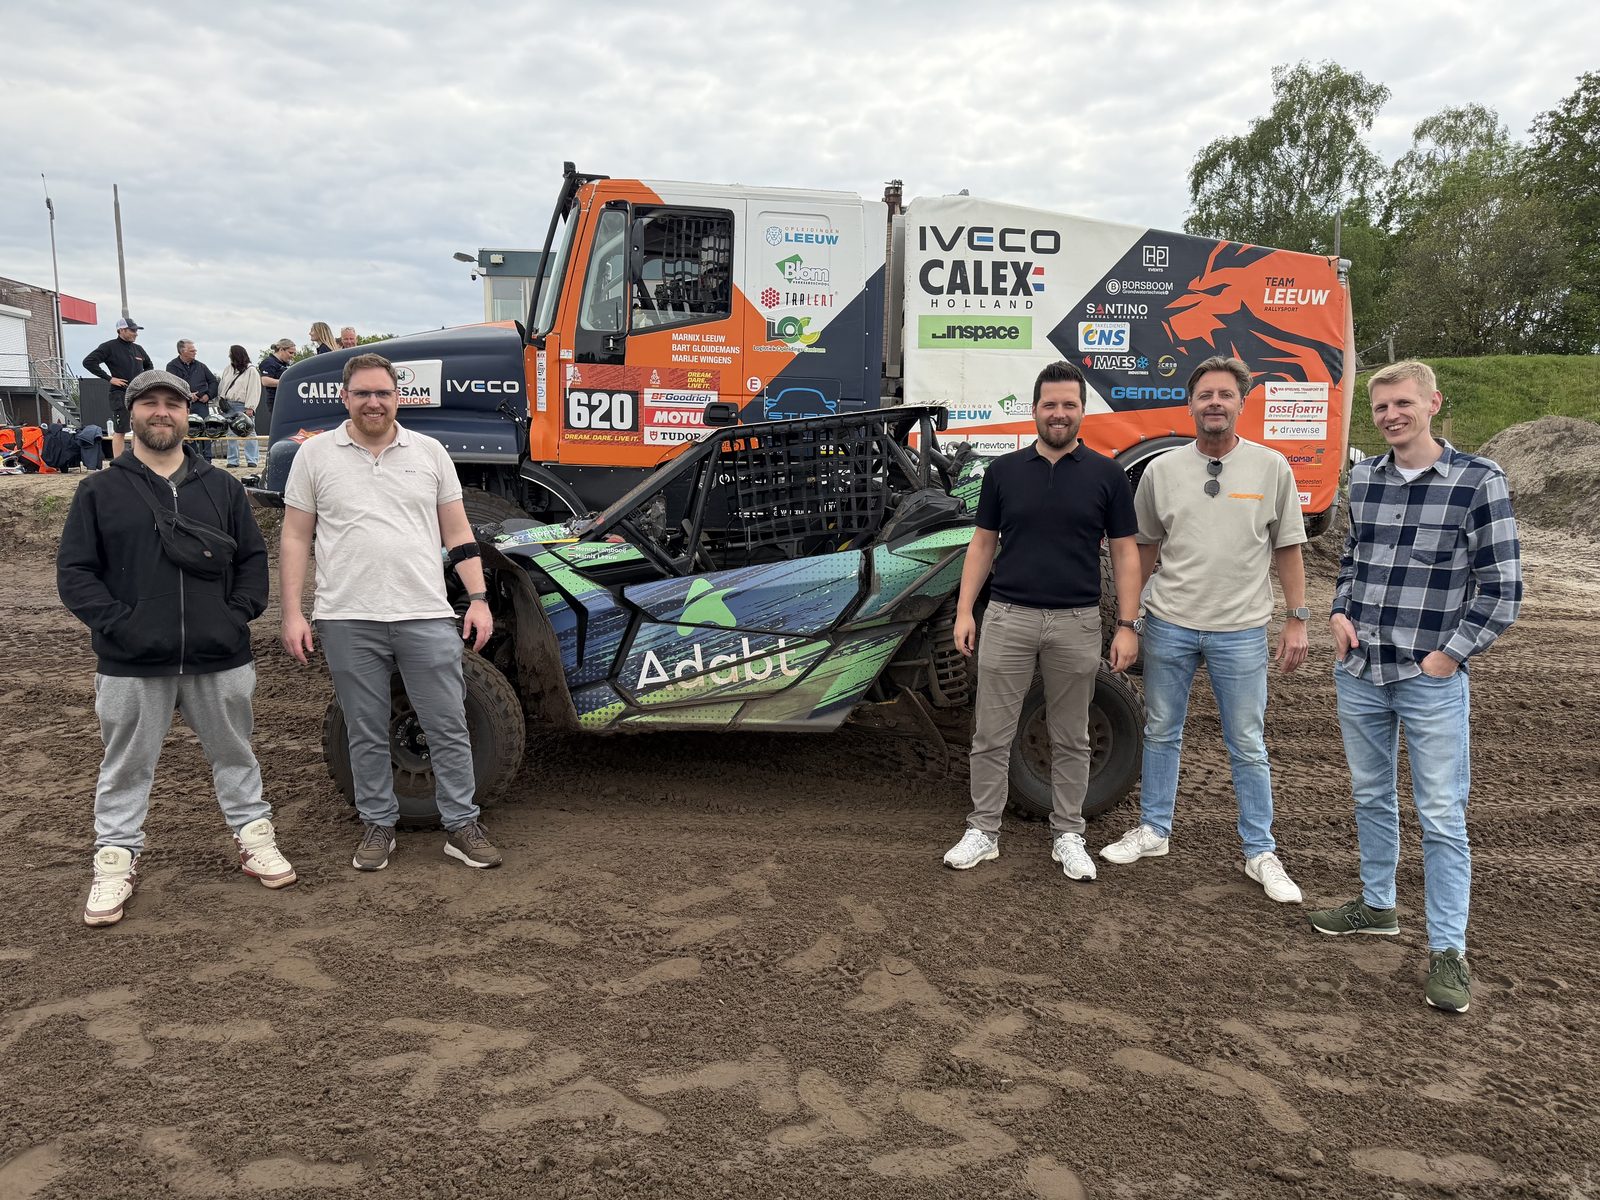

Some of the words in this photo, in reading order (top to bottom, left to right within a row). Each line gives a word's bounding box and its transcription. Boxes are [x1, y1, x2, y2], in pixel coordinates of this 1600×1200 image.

[784, 232, 839, 245] LEEUW
[919, 225, 1061, 255] IVECO
[783, 260, 830, 282] Blom
[919, 258, 1034, 297] CALEX
[1121, 280, 1174, 291] BORSBOOM
[1264, 276, 1295, 287] TEAM
[785, 292, 834, 307] TRALERT
[1263, 288, 1331, 305] LEEUW
[930, 299, 1034, 309] HOLLAND
[1086, 302, 1148, 315] SANTINO
[766, 315, 821, 345] LOC
[944, 325, 1020, 341] inspace
[671, 333, 700, 342] MARNIX
[701, 334, 726, 343] LEEUW
[1083, 329, 1126, 346] CNS
[671, 344, 690, 352] BART
[692, 345, 741, 354] GLOUDEMANS
[671, 354, 699, 363] MARIJE
[699, 355, 733, 365] WINGENS
[1093, 355, 1137, 370] MAES
[297, 382, 344, 399] CALEX
[446, 379, 520, 393] IVECO
[651, 392, 712, 402] BFGoodrich
[1111, 386, 1186, 400] GEMCO
[399, 397, 431, 405] RUCKS
[569, 391, 633, 430] 620
[948, 410, 993, 420] EEUW
[1279, 425, 1321, 434] drivewise
[564, 433, 592, 441] DREAM.
[979, 441, 1016, 450] newtone
[636, 637, 800, 690] Adabt
